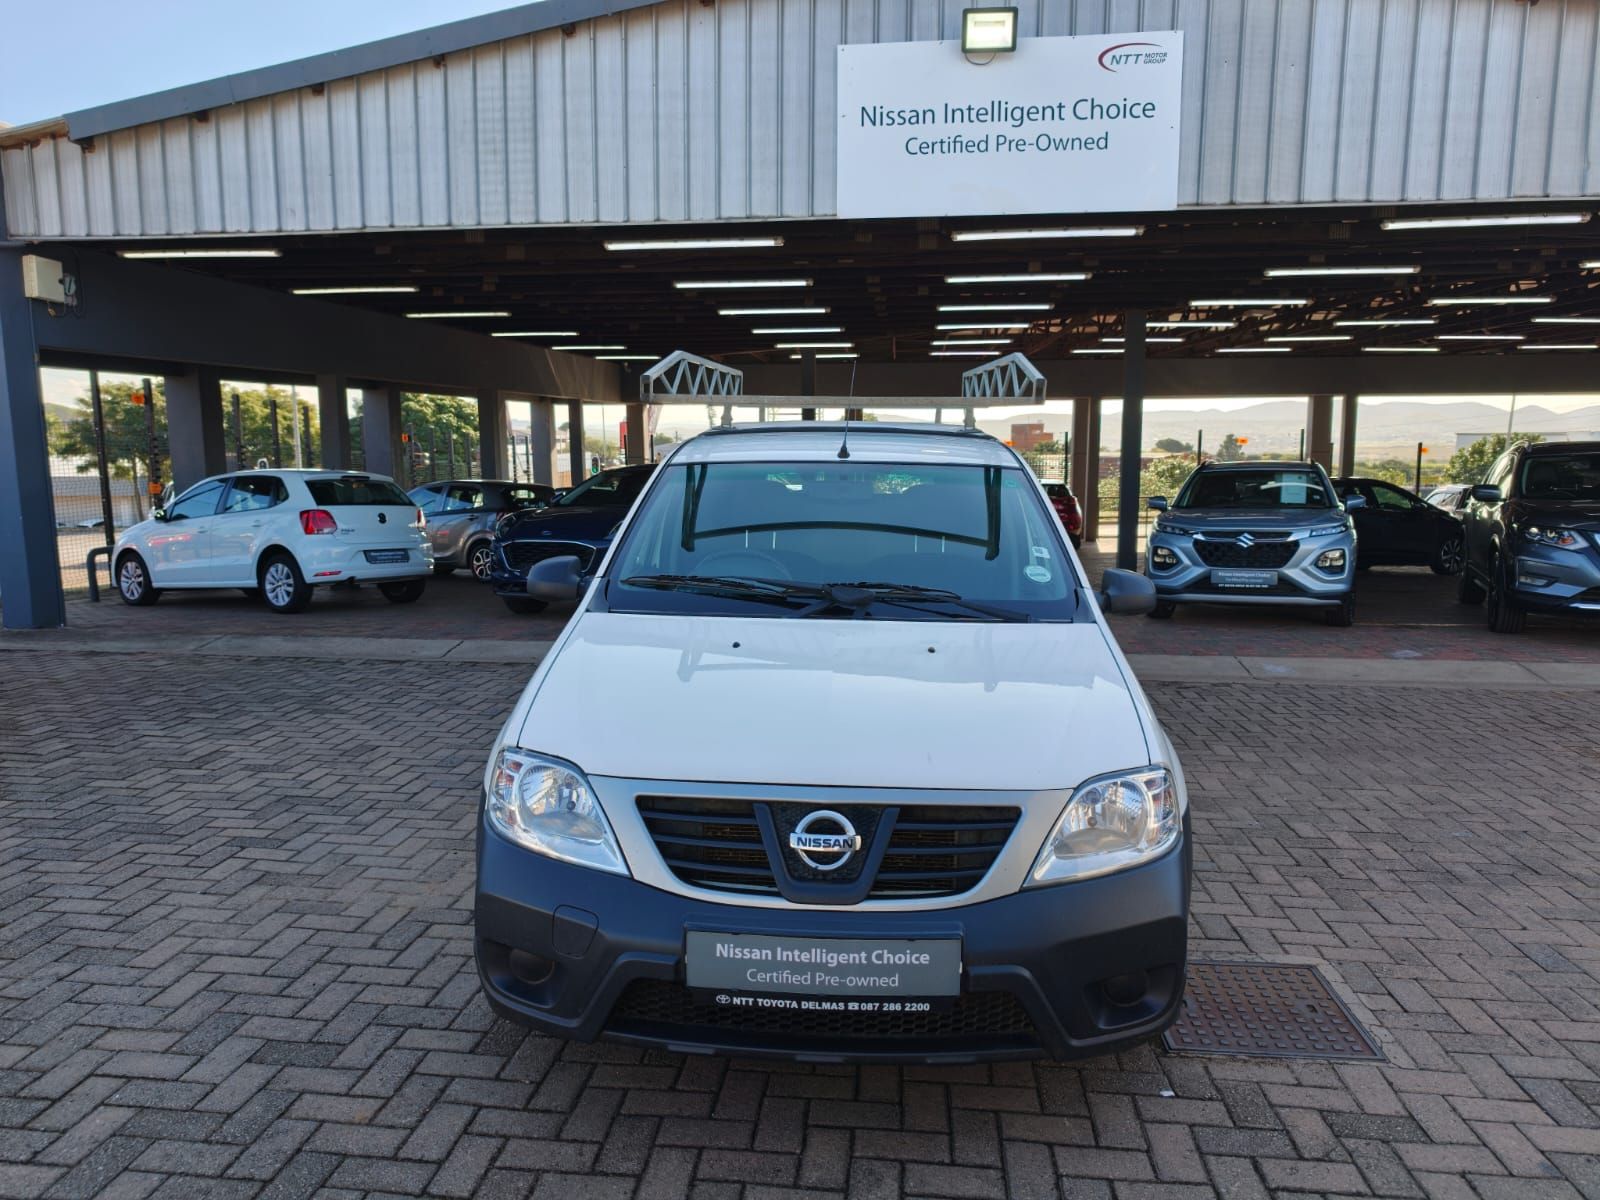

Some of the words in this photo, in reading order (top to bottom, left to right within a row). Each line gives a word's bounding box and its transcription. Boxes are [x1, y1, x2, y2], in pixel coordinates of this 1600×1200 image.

[1110, 53, 1143, 66] NTT
[860, 105, 936, 127] Nissan
[944, 100, 1065, 128] Intelligent
[1072, 97, 1157, 121] Choice
[905, 135, 989, 156] Certified
[995, 131, 1109, 153] Pre-Owned
[796, 836, 853, 849] NISSAN
[716, 943, 772, 961] Nissan
[777, 947, 868, 967] Intelligent
[871, 950, 930, 965] Choice
[746, 968, 811, 985] Certified
[816, 972, 899, 987] Pre-owned
[733, 997, 754, 1006] NTT
[757, 999, 798, 1009] TOYOTA
[801, 1001, 845, 1010] DELMAS
[860, 1002, 880, 1011] 087
[883, 1002, 902, 1011] 286
[904, 1002, 930, 1012] 2200
